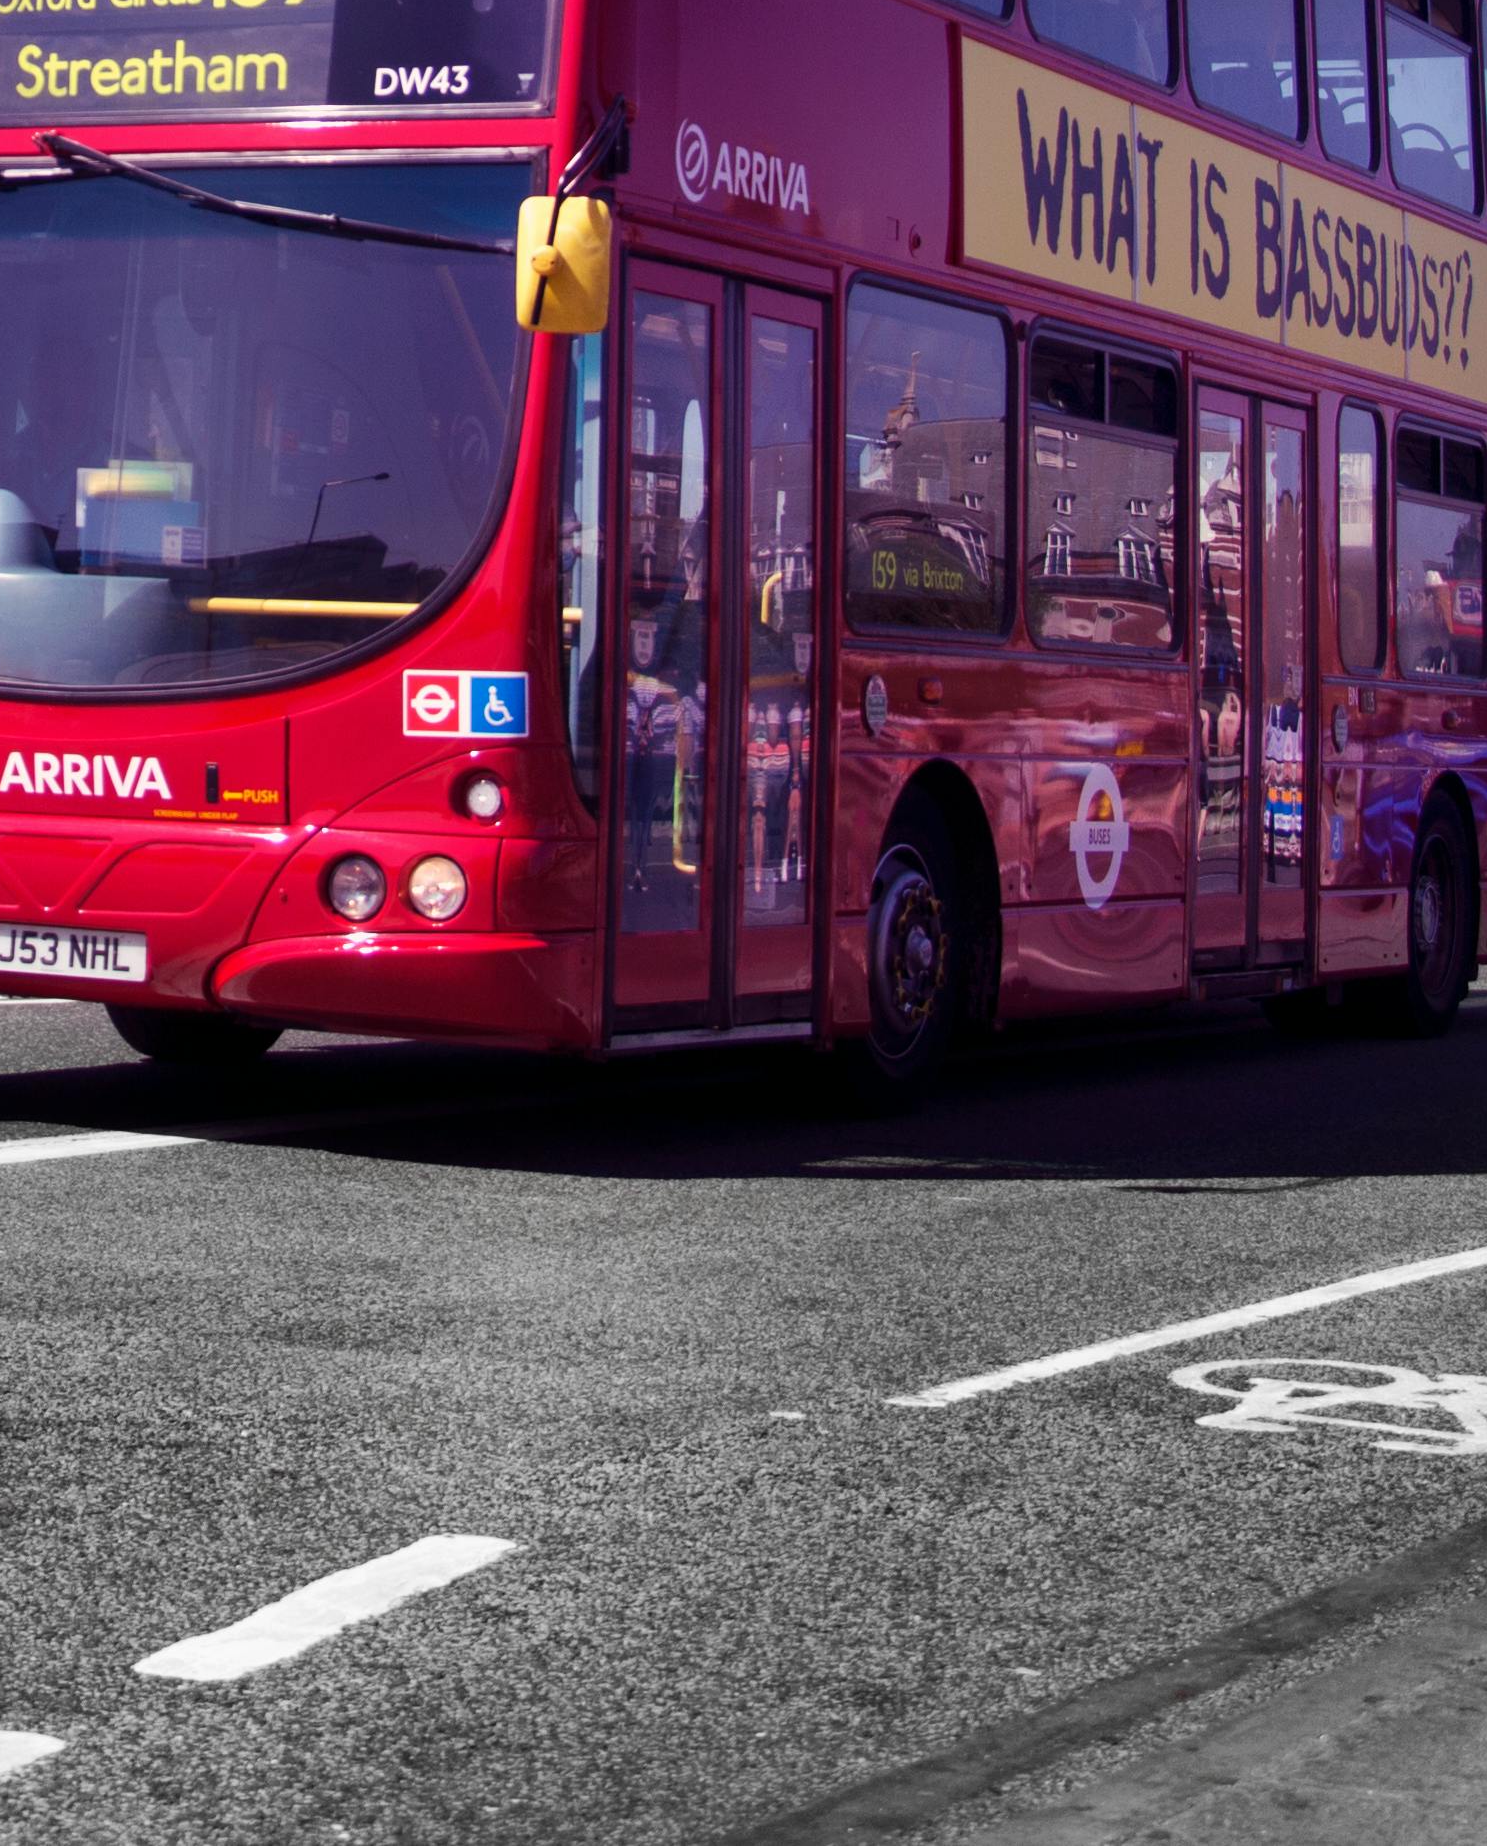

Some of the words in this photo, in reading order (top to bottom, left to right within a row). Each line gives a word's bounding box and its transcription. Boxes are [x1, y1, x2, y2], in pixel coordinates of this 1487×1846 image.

[15, 40, 288, 99] Streatham
[374, 65, 470, 96] DW43
[711, 141, 810, 216] ARRIVA
[1017, 88, 1163, 286] WHAT
[1191, 158, 1230, 300] IS
[1255, 177, 1473, 370] BASSBUDS??
[872, 551, 896, 589] 159
[904, 562, 919, 587] via
[922, 561, 963, 590] Brixton
[243, 789, 278, 803] PUSH
[1089, 828, 1110, 844] BUSES
[69, 933, 130, 972] NHL
